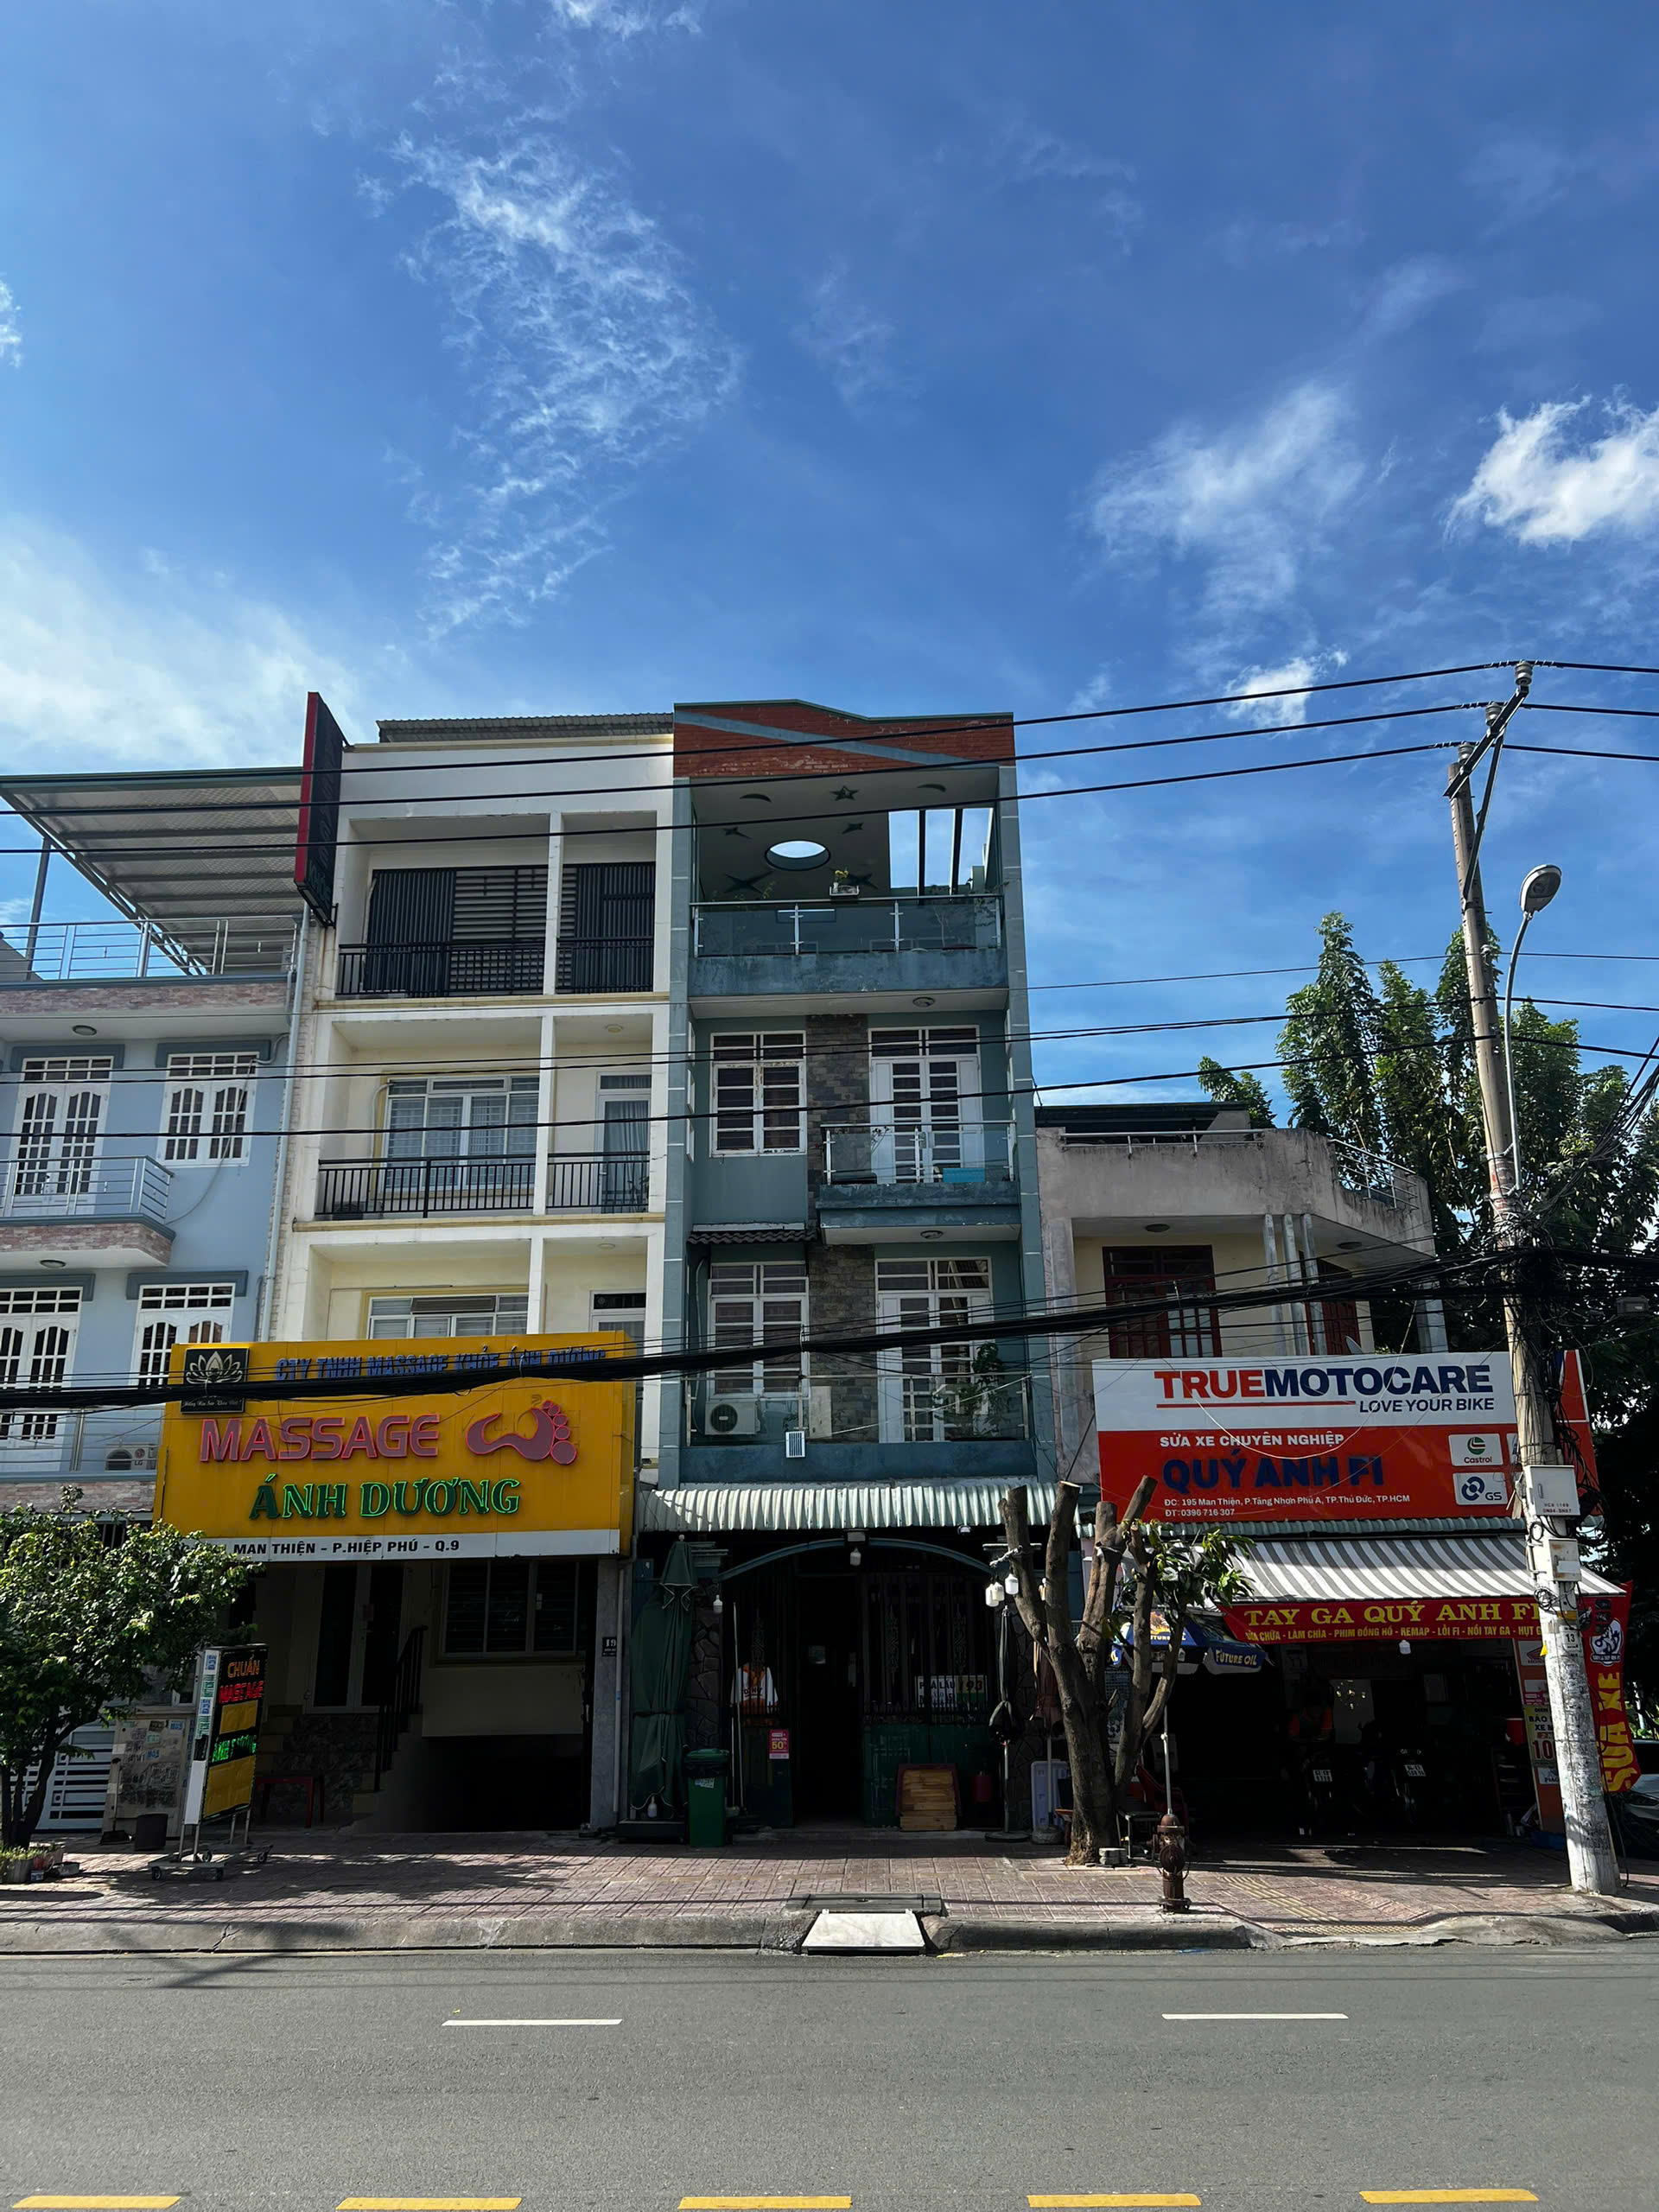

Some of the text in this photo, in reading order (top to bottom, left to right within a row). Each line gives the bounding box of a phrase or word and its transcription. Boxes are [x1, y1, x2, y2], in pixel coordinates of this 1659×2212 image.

[1154, 1364, 1493, 1398] TRUEMOTOCARE
[1360, 1398, 1494, 1414] LOVE YOUR BIKE
[199, 1414, 440, 1462] MASSAGE
[1160, 1431, 1344, 1447] SỬA XE CHUYÊN NGHIỆP
[1162, 1448, 1384, 1494] QUÝ ANH FI
[250, 1473, 521, 1519] ÁNH DƯƠNG
[1485, 1492, 1503, 1501] GS
[233, 1543, 266, 1554] MAN
[271, 1541, 315, 1556] THIỆN
[333, 1540, 382, 1555] P.HIỆP
[387, 1538, 418, 1553] PHÚ
[435, 1540, 460, 1553] Q.9
[1244, 1608, 1300, 1626] TAY
[1311, 1607, 1354, 1624] GA
[1363, 1600, 1426, 1624] QUÝ
[1435, 1603, 1502, 1621] ANH
[1334, 1629, 1356, 1638] PHIM
[1401, 1626, 1430, 1637] REMAP
[1452, 1626, 1460, 1636] FI
[1484, 1625, 1497, 1635] TAY
[1499, 1625, 1511, 1635] GA
[1565, 1633, 1575, 1643] 13
[1215, 1648, 1258, 1666] FUTURE OIL
[1598, 1672, 1623, 1712] XE
